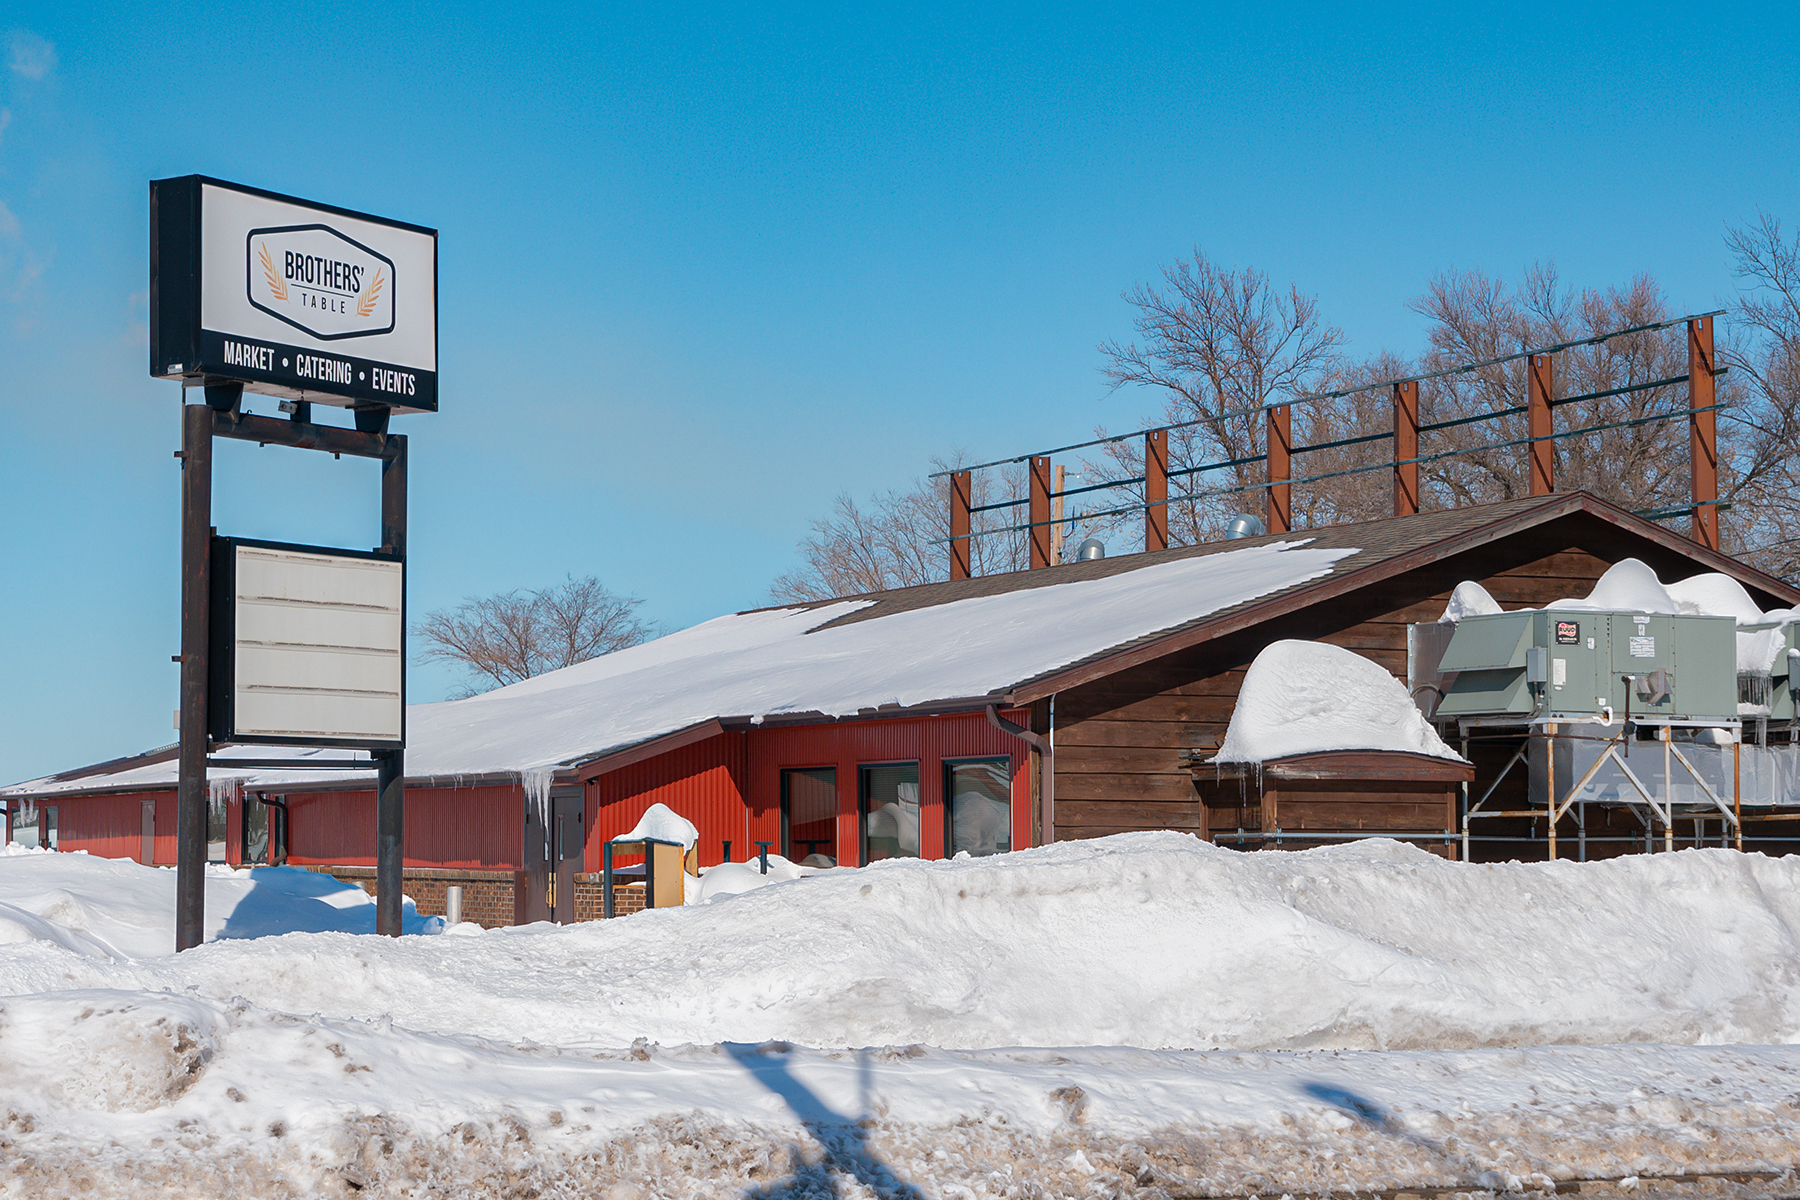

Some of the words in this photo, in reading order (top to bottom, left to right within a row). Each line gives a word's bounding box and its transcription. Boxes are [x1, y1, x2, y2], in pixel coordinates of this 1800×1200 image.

[285, 250, 364, 293] BROTHERS'
[302, 293, 345, 314] TABLE
[224, 340, 275, 371] MARKET
[296, 354, 352, 385] CATERING
[372, 367, 415, 396] EVENTS
